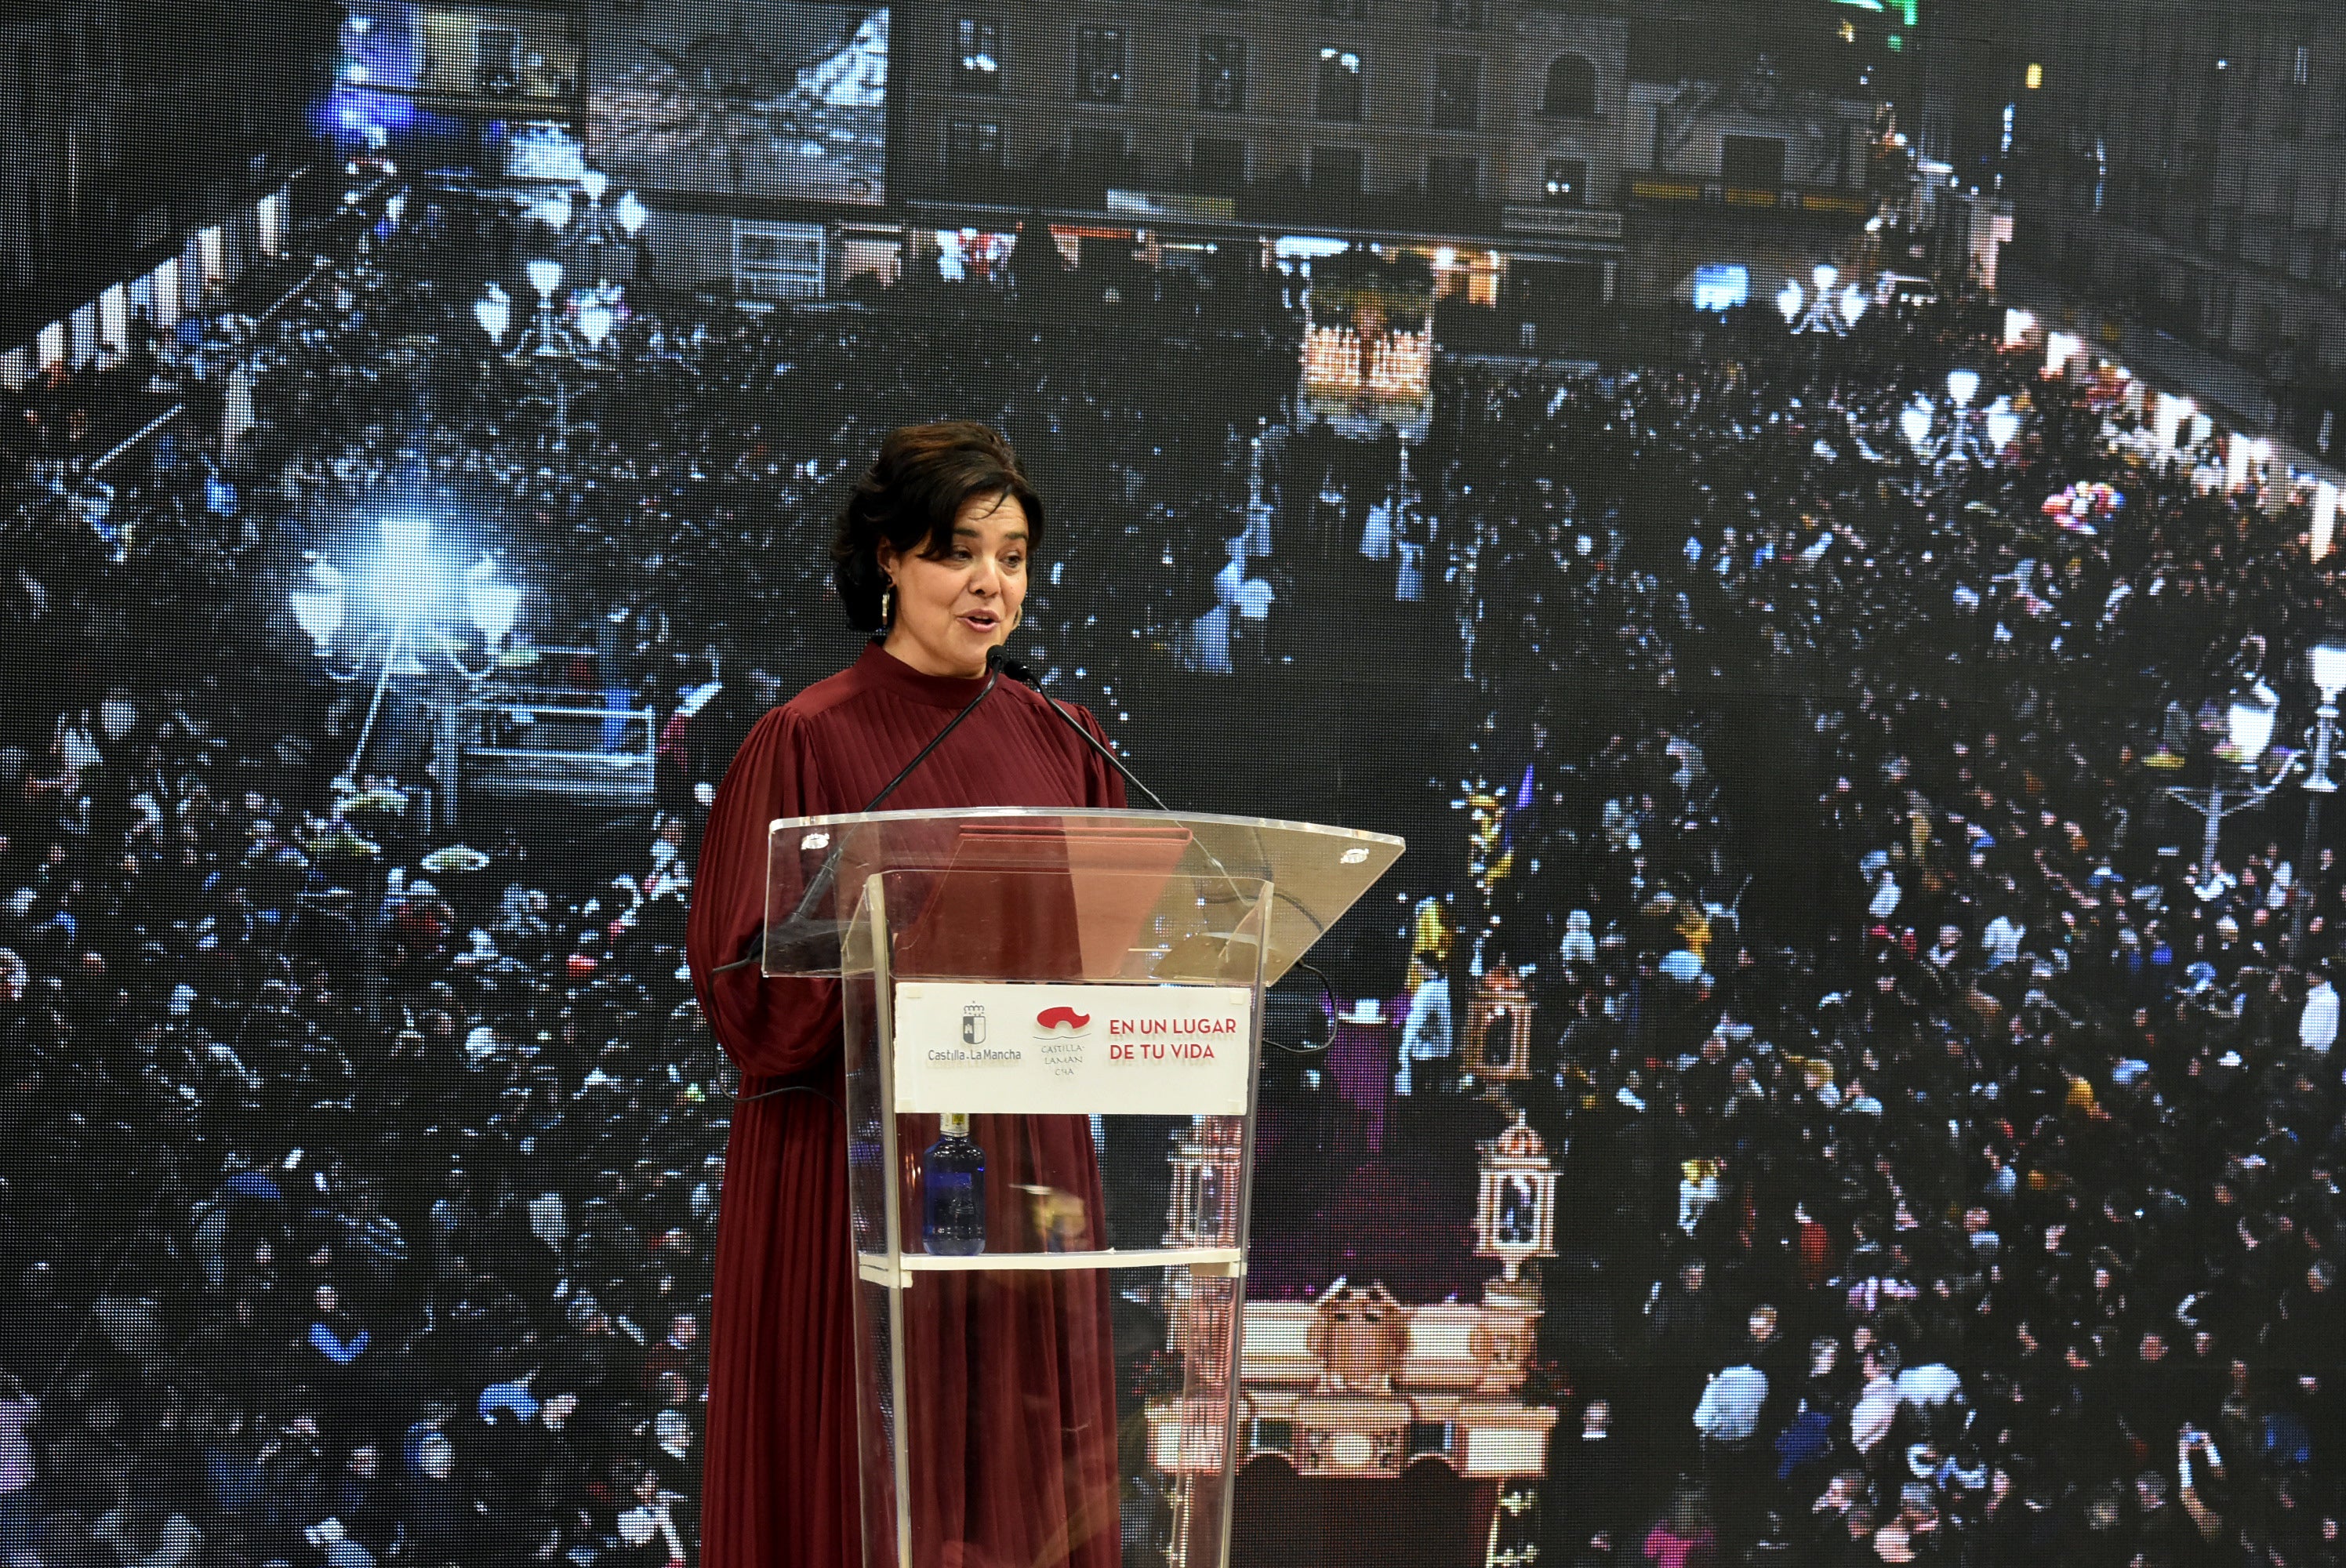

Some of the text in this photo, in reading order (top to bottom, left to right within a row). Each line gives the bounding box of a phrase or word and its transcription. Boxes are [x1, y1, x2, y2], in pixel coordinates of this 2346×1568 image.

[1109, 1018, 1237, 1035] EN UN LUGAR
[983, 1049, 1022, 1060] Mancha
[1109, 1044, 1215, 1060] DE TU VIDA
